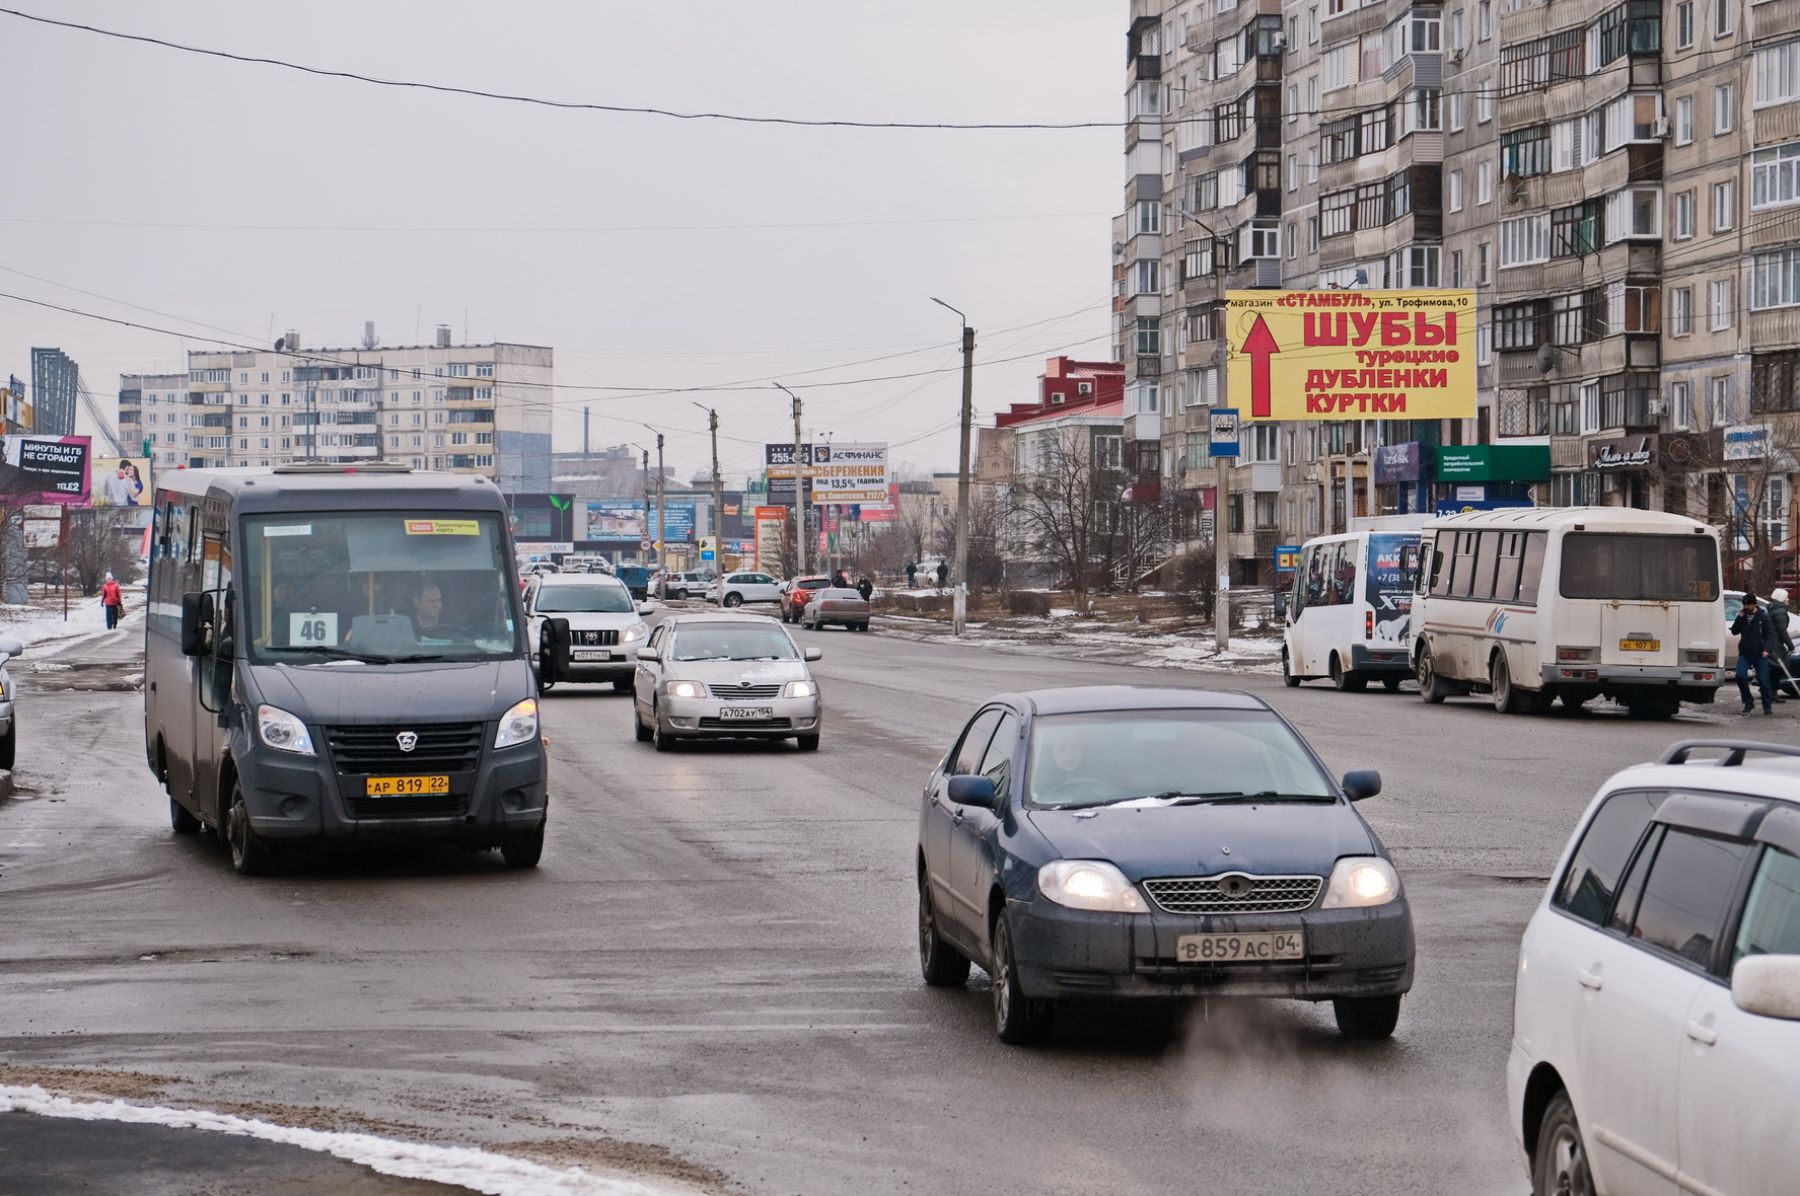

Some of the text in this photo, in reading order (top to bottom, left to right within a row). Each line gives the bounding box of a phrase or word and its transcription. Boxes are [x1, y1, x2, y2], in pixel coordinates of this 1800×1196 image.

[1379, 299, 1394, 308] ул.
[1303, 312, 1457, 347] ШУБЫ
[1355, 350, 1460, 368] турецкие
[1304, 369, 1448, 392] ДУБЛЕНКИ
[1306, 393, 1406, 413] КУРТКИ
[24, 443, 82, 455] МИНУТЫ И ГБ
[845, 451, 883, 459] ФИНАНС
[23, 452, 79, 463] НЕ СГОРАЮТ
[56, 482, 80, 492] TELE2
[300, 620, 327, 641] 46
[374, 777, 445, 793] АР 819 22
[1275, 935, 1297, 951] 04
